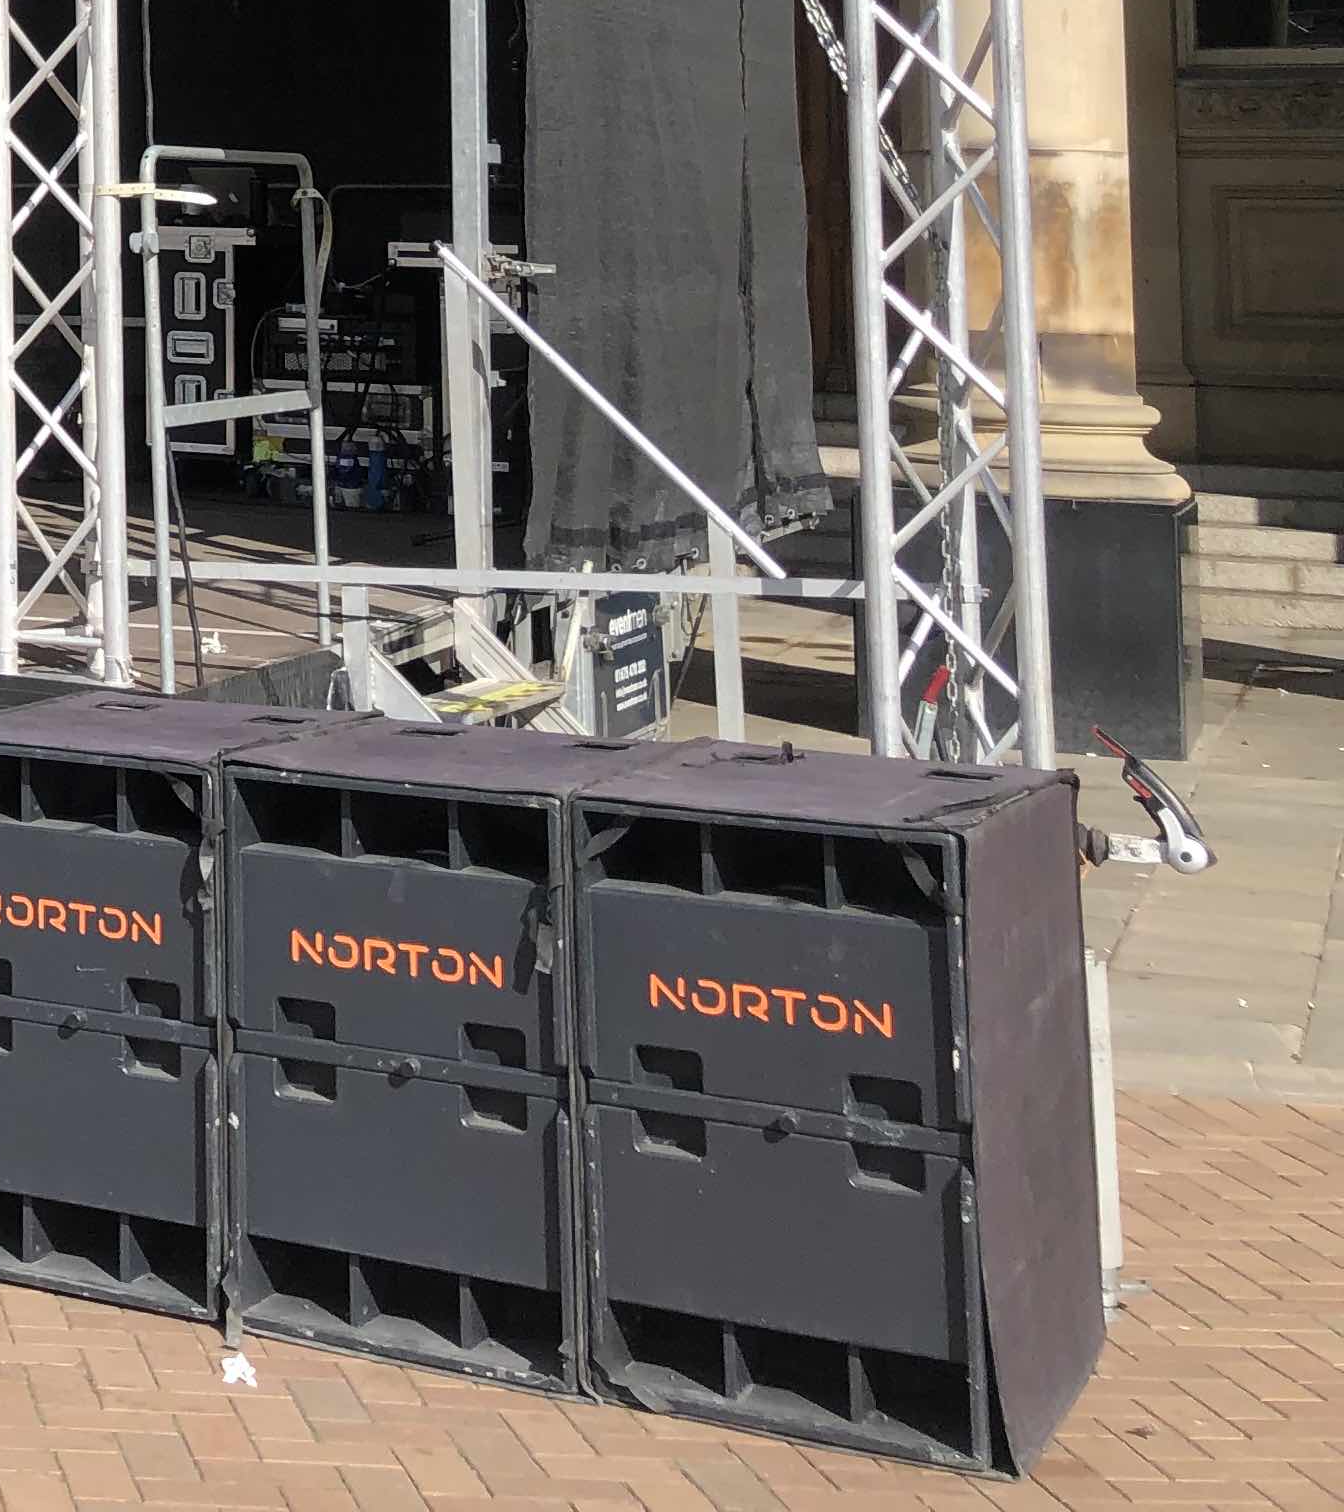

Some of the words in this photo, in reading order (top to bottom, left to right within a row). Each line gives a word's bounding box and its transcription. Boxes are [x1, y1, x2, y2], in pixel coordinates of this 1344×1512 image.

[609, 608, 647, 636] eventmen
[290, 929, 505, 989] NORTON
[649, 972, 895, 1040] NORTON
